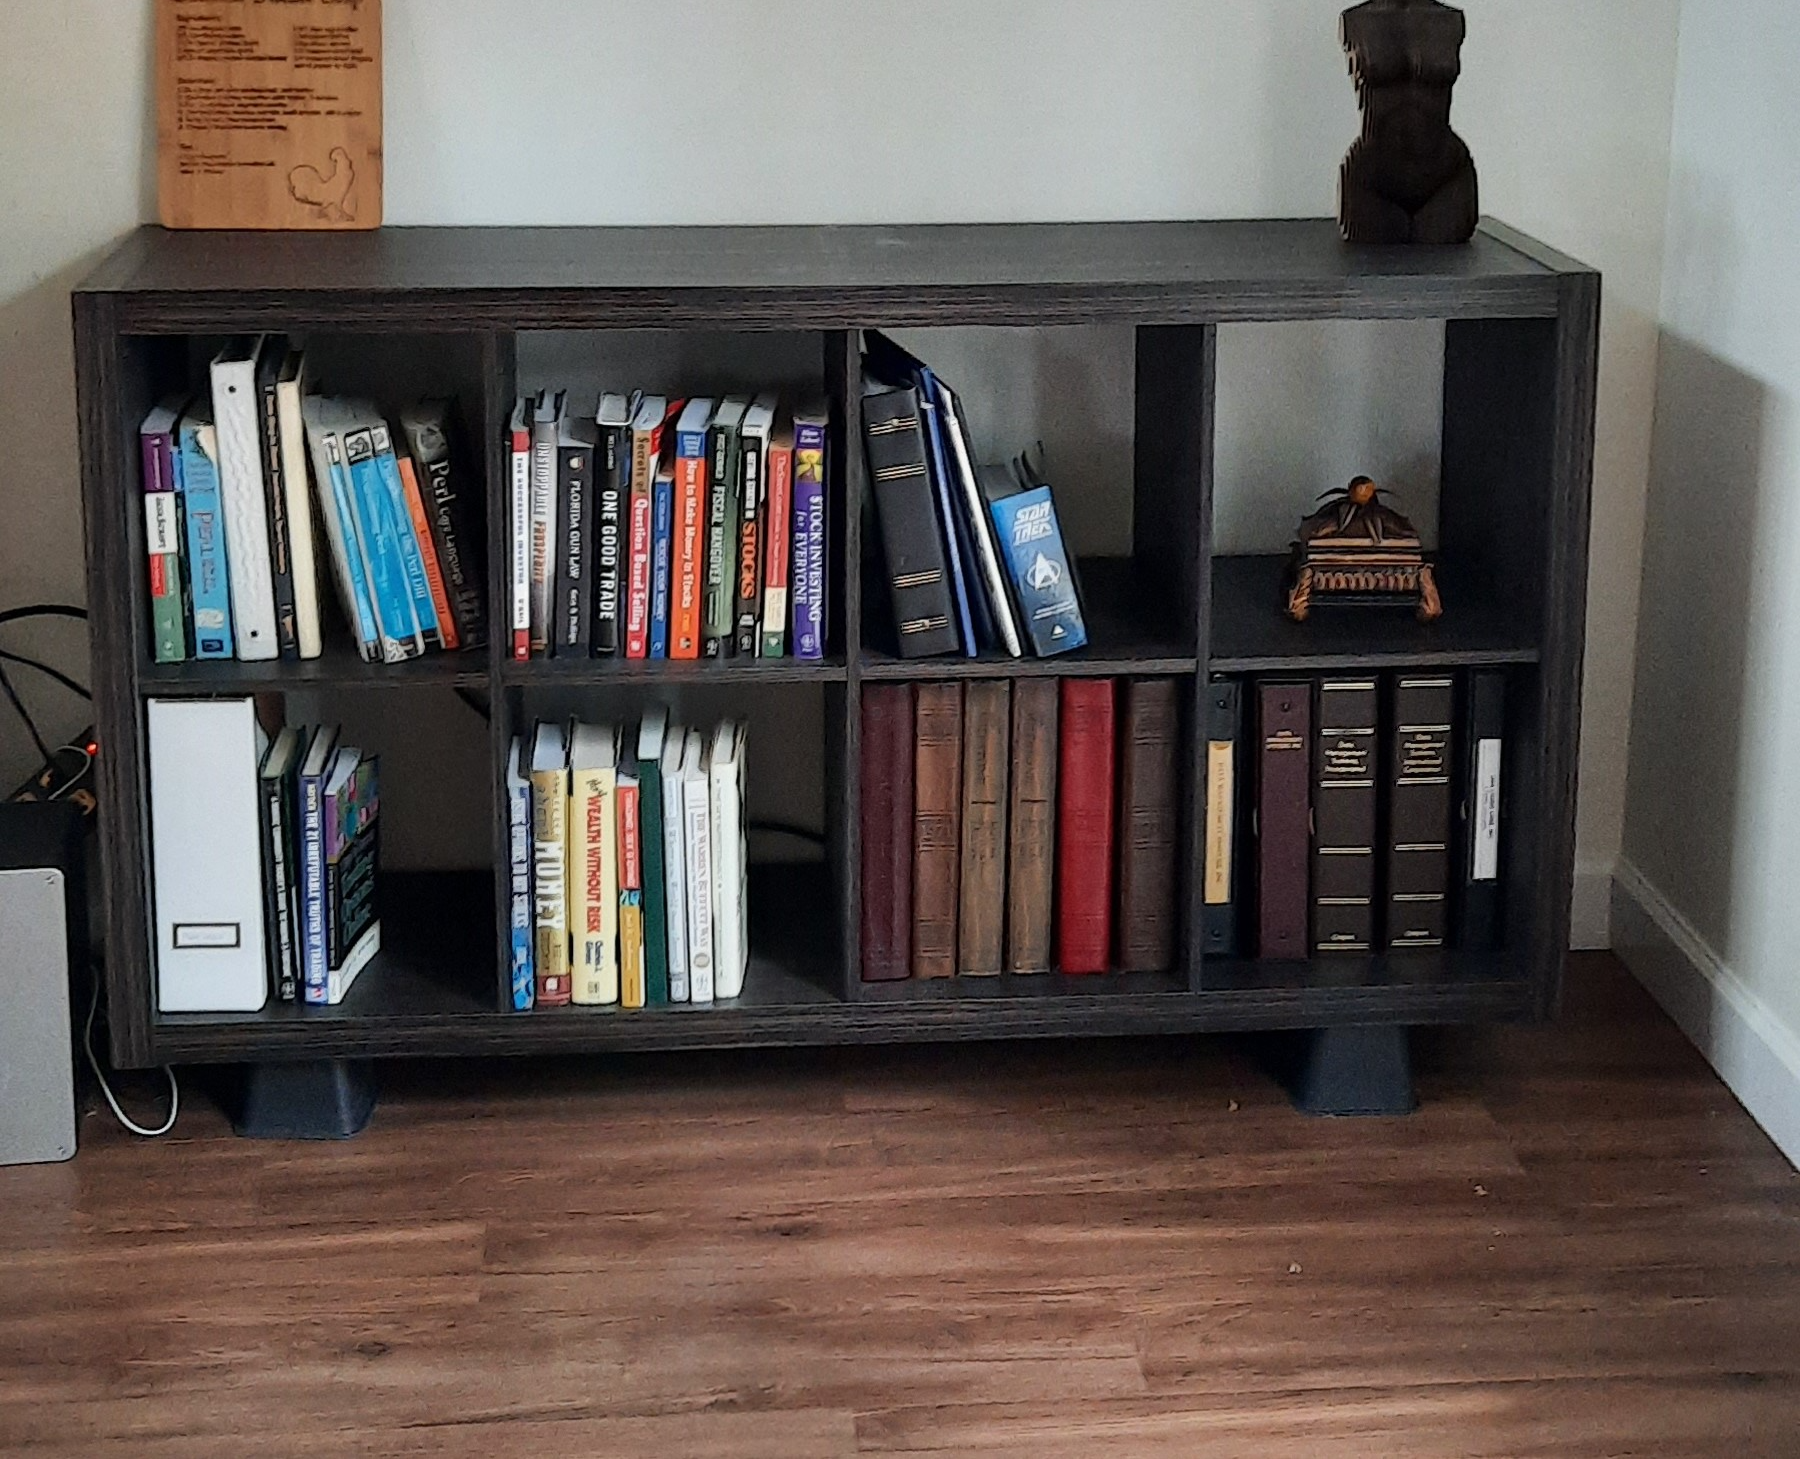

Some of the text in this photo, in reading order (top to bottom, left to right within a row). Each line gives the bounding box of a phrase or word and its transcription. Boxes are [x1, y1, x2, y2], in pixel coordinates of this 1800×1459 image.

[636, 437, 649, 477] Secrets
[687, 460, 698, 483] How
[429, 459, 457, 505] Perl
[686, 484, 697, 496] to
[685, 497, 697, 525] Make
[711, 486, 726, 525] FISCAL
[1015, 500, 1052, 524] STAR
[568, 480, 581, 579] FLORIDA GUN LAW
[682, 526, 696, 561] Money
[1013, 517, 1053, 546] TREK
[598, 490, 618, 620] ONE GOOD TRADE
[628, 498, 646, 632] Question Based Selling
[684, 562, 694, 573] in
[709, 526, 724, 585] HANGOVER
[741, 521, 756, 600] STOCKS
[795, 510, 808, 605] for EVERYONE
[808, 495, 823, 622] STOCK INVESTING
[682, 574, 695, 609] Stocks
[305, 811, 319, 829] THE
[587, 796, 601, 844] WEALTH
[587, 847, 601, 902] WITHOUT
[697, 835, 708, 877] WARREN
[534, 840, 566, 931] MONEY
[698, 880, 709, 925] BUFFETT
[308, 900, 322, 934] TRUTHS
[586, 905, 601, 934] RISK
[309, 934, 322, 945] OF
[309, 948, 323, 985] TRADING
